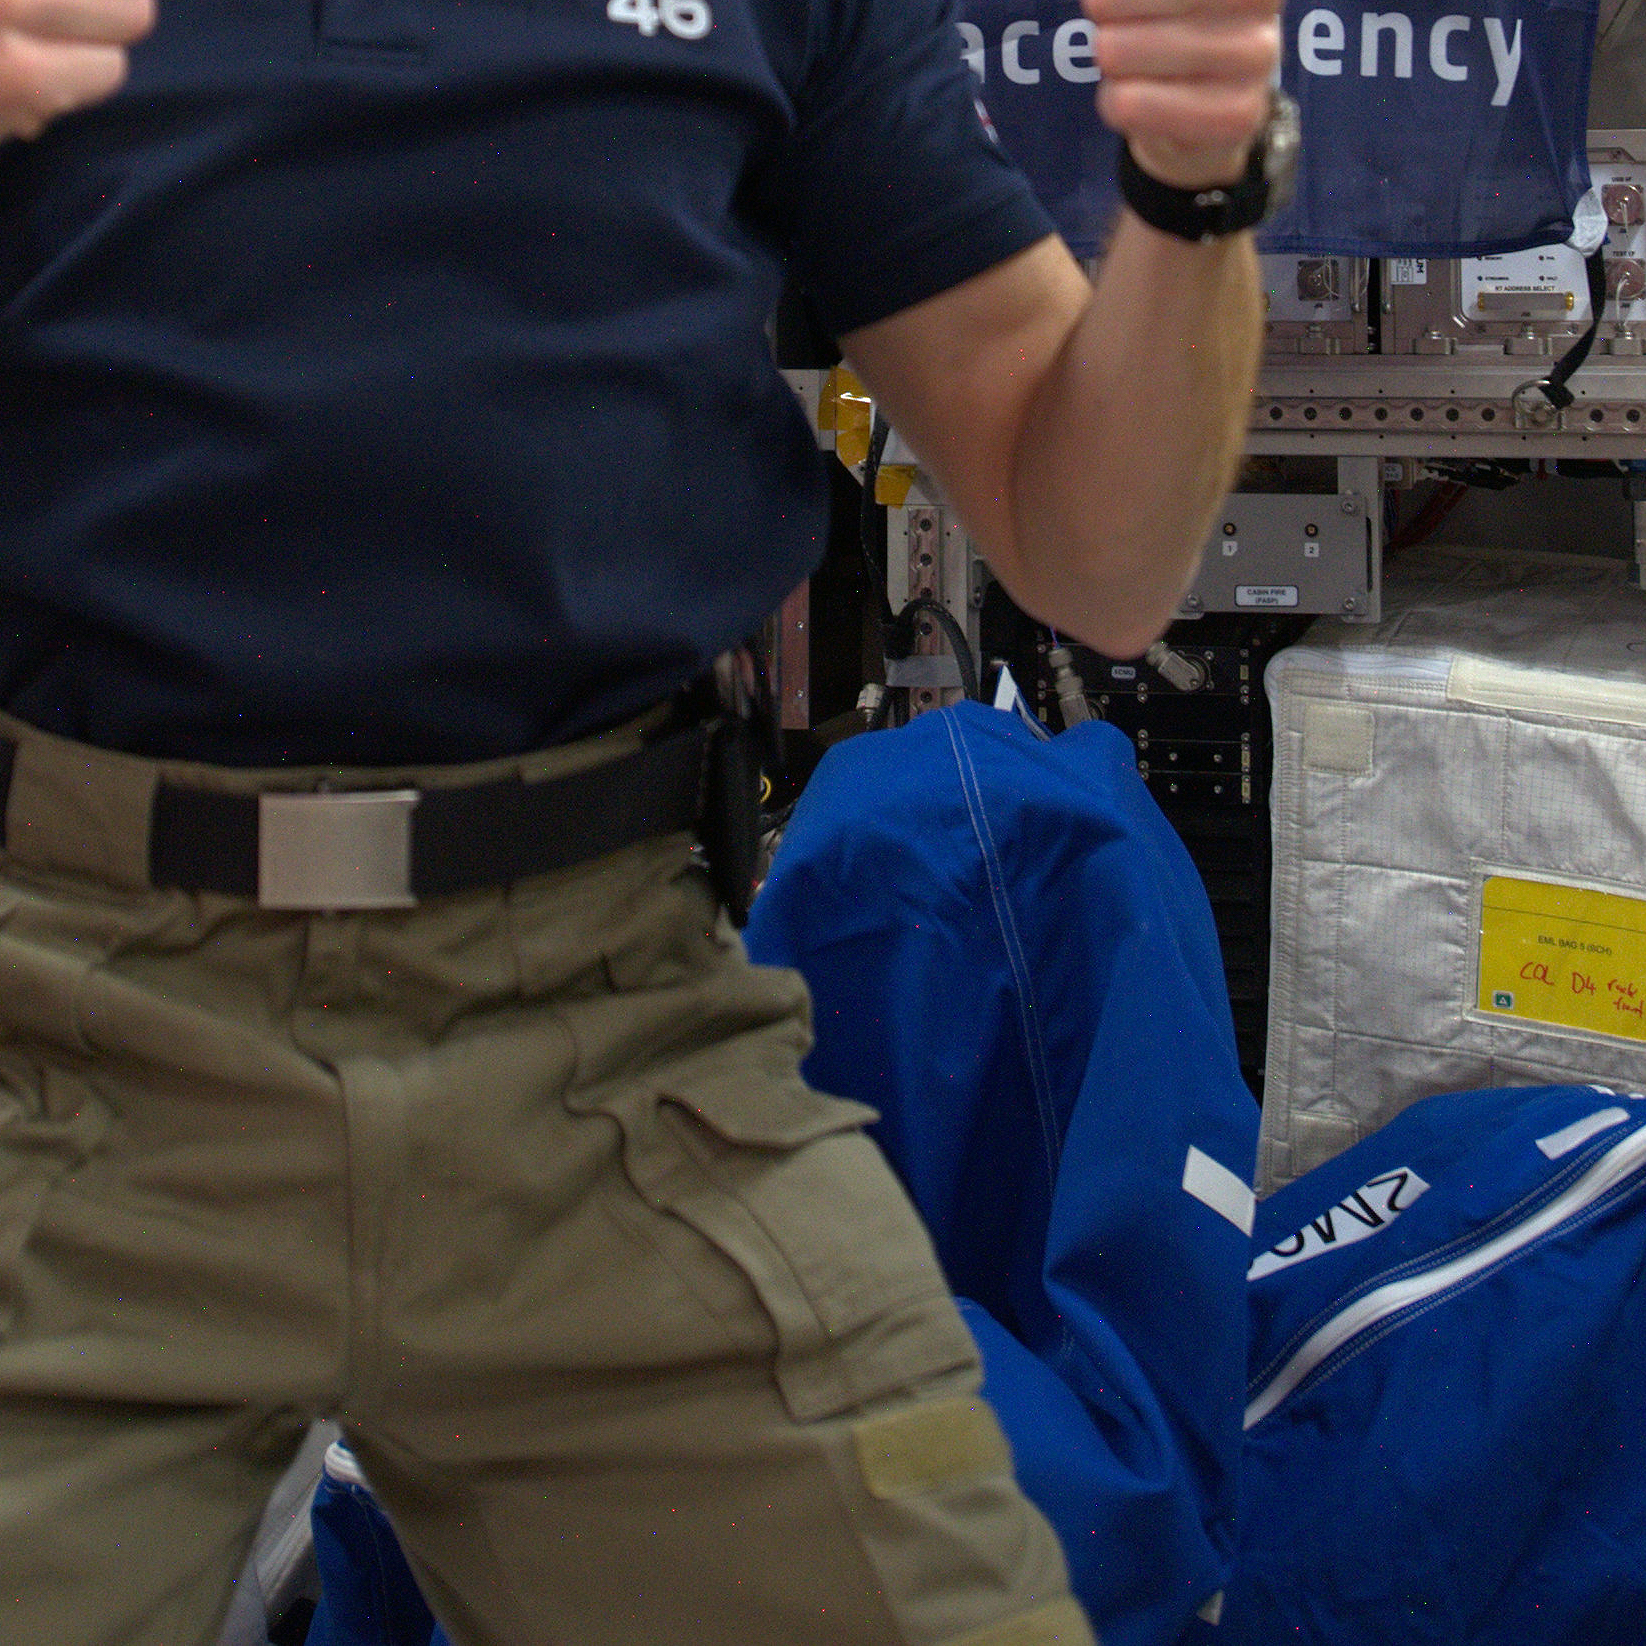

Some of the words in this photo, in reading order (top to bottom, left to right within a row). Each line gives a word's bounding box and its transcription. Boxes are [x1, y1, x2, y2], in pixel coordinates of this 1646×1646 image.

[1538, 935, 1555, 947] EML
[1558, 939, 1578, 950] BAG
[1587, 943, 1612, 956] (SCH)
